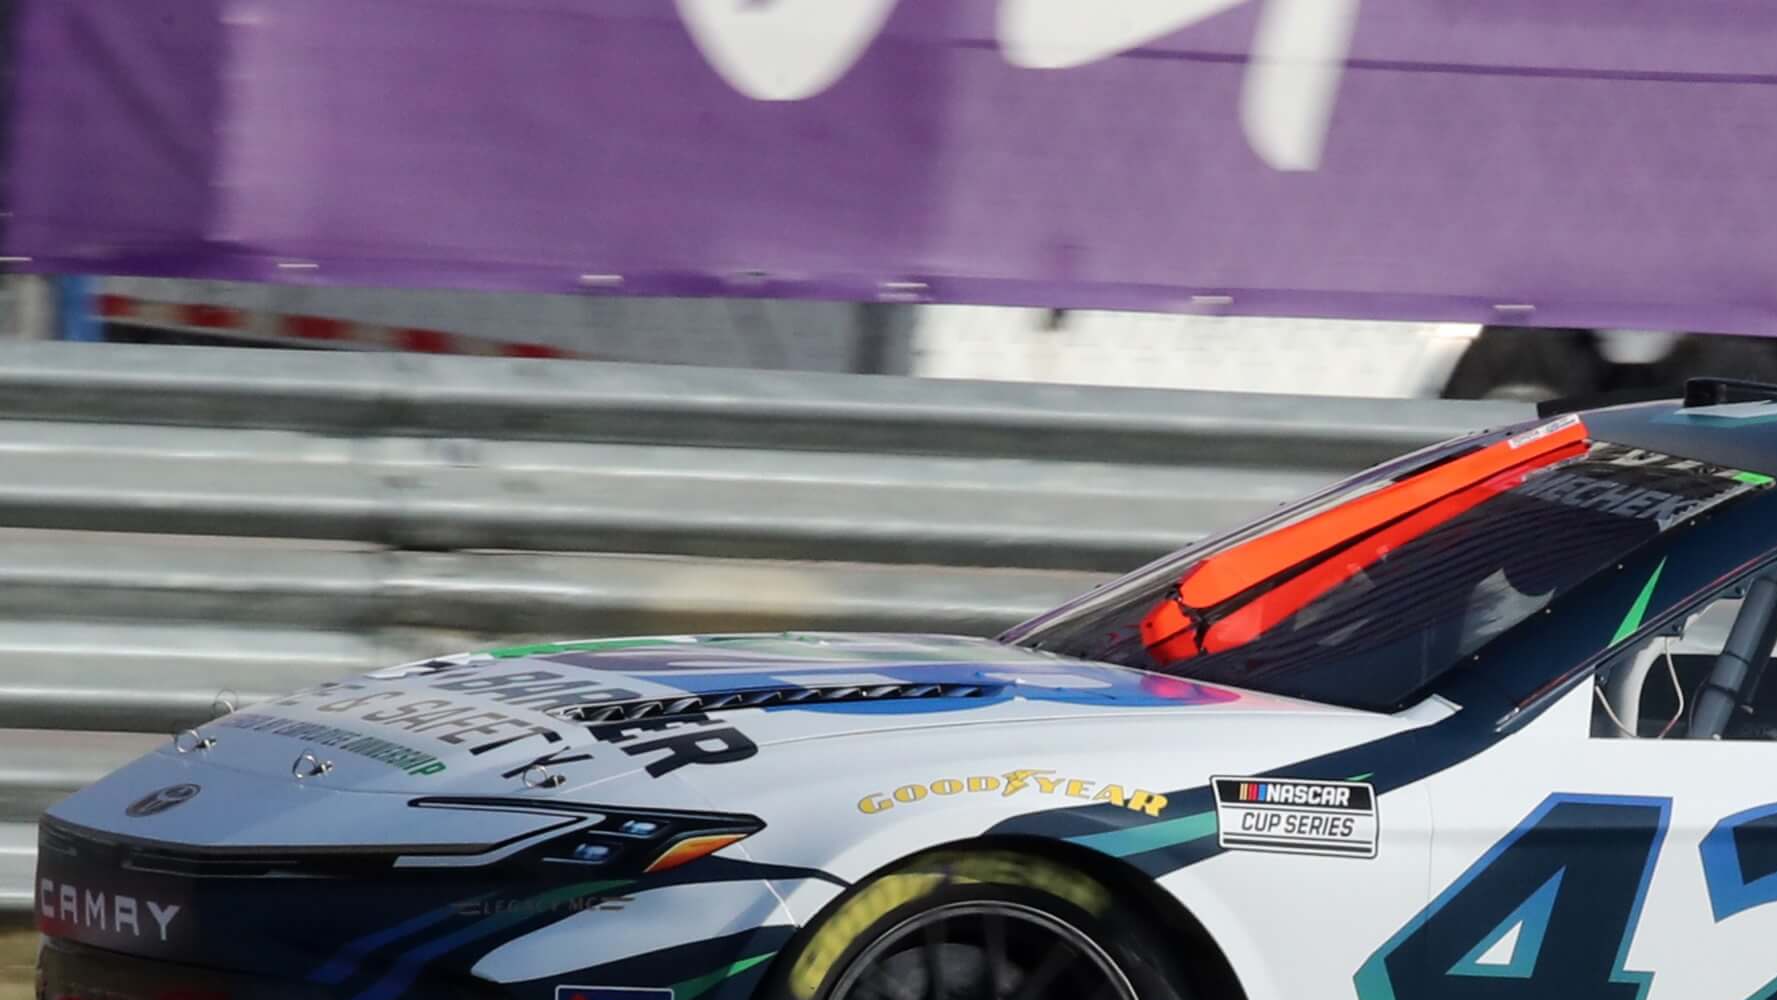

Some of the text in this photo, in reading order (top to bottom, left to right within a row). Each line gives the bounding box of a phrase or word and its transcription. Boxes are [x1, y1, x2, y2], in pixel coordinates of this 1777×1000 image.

[858, 769, 1169, 818] GOODYEAR
[1265, 783, 1351, 807] NASCAR
[1241, 811, 1355, 838] CUP SERIES
[40, 878, 181, 942] CAMRY
